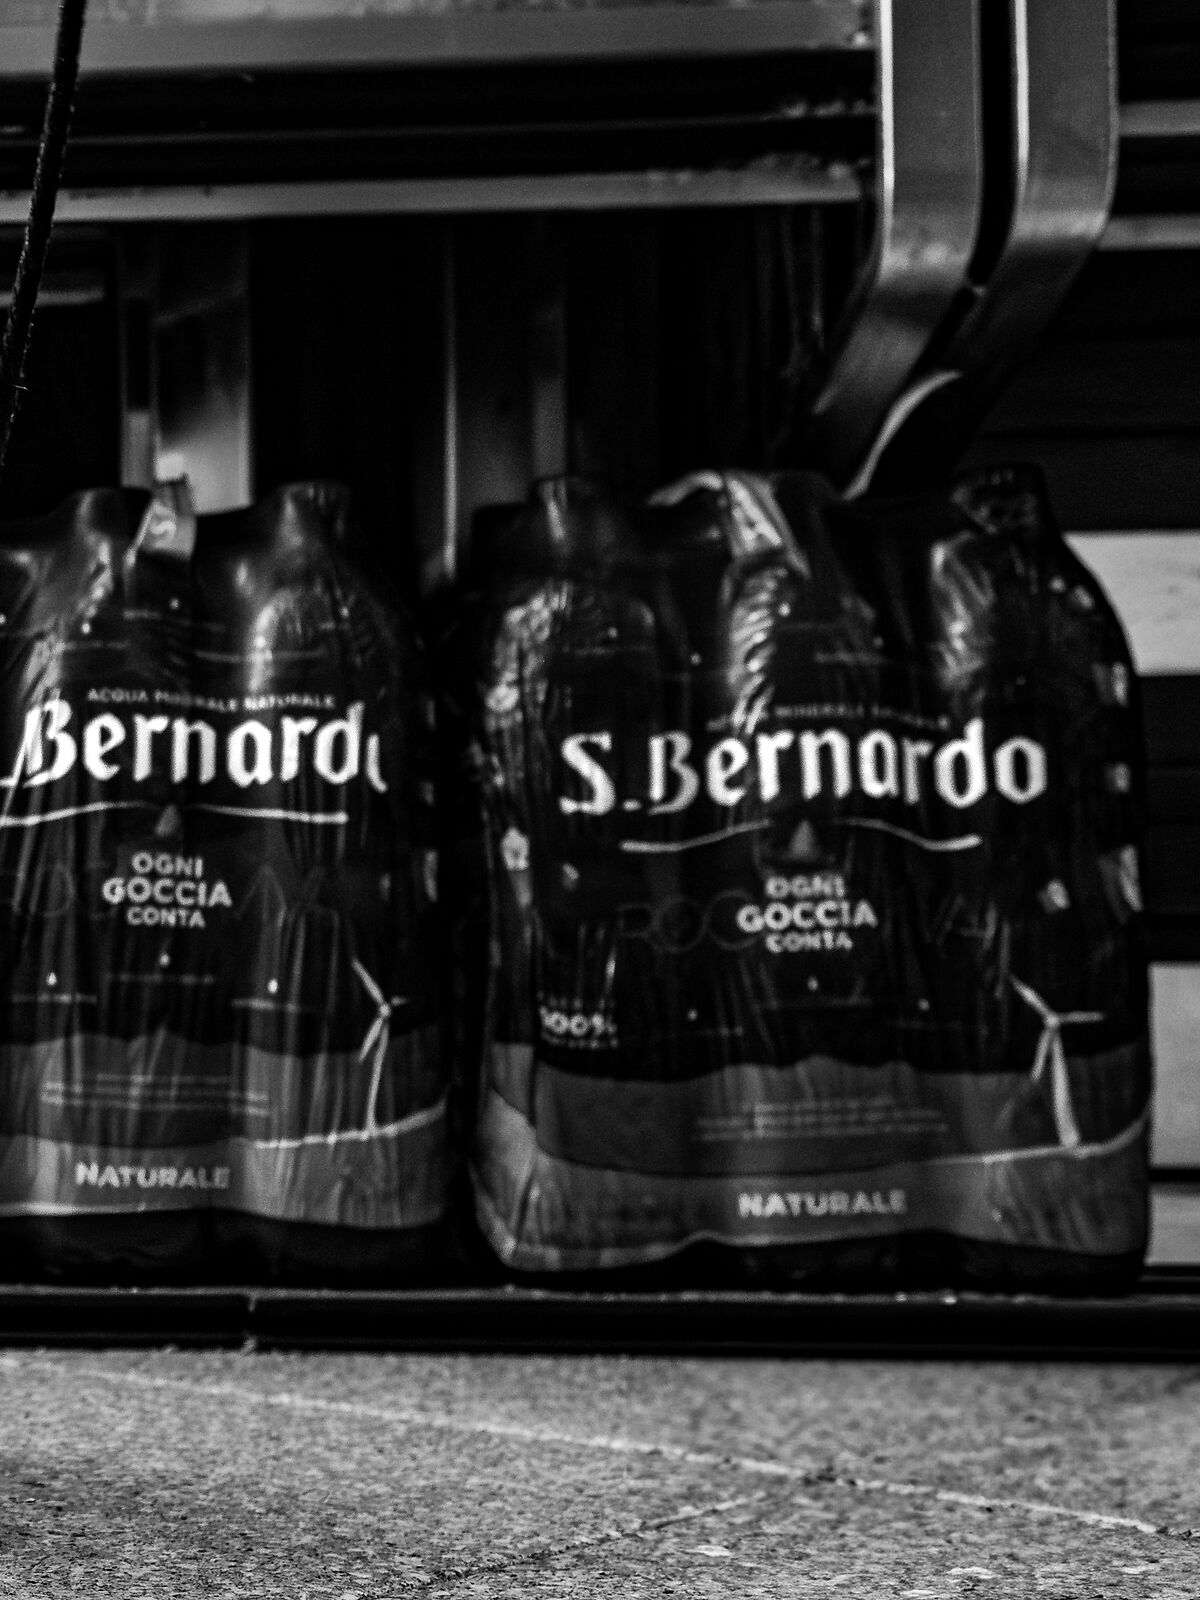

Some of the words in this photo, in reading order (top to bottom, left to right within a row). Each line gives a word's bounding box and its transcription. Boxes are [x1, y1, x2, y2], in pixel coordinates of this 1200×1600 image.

[131, 852, 204, 879] OGNI
[102, 877, 233, 907] GOCCIA
[765, 874, 846, 899] OGNI
[127, 906, 205, 929] CONTA
[736, 899, 879, 933] GOCCIA
[765, 930, 853, 953] CONTA
[75, 1162, 230, 1189] NATURALE
[738, 1189, 906, 1218] NATURALE
